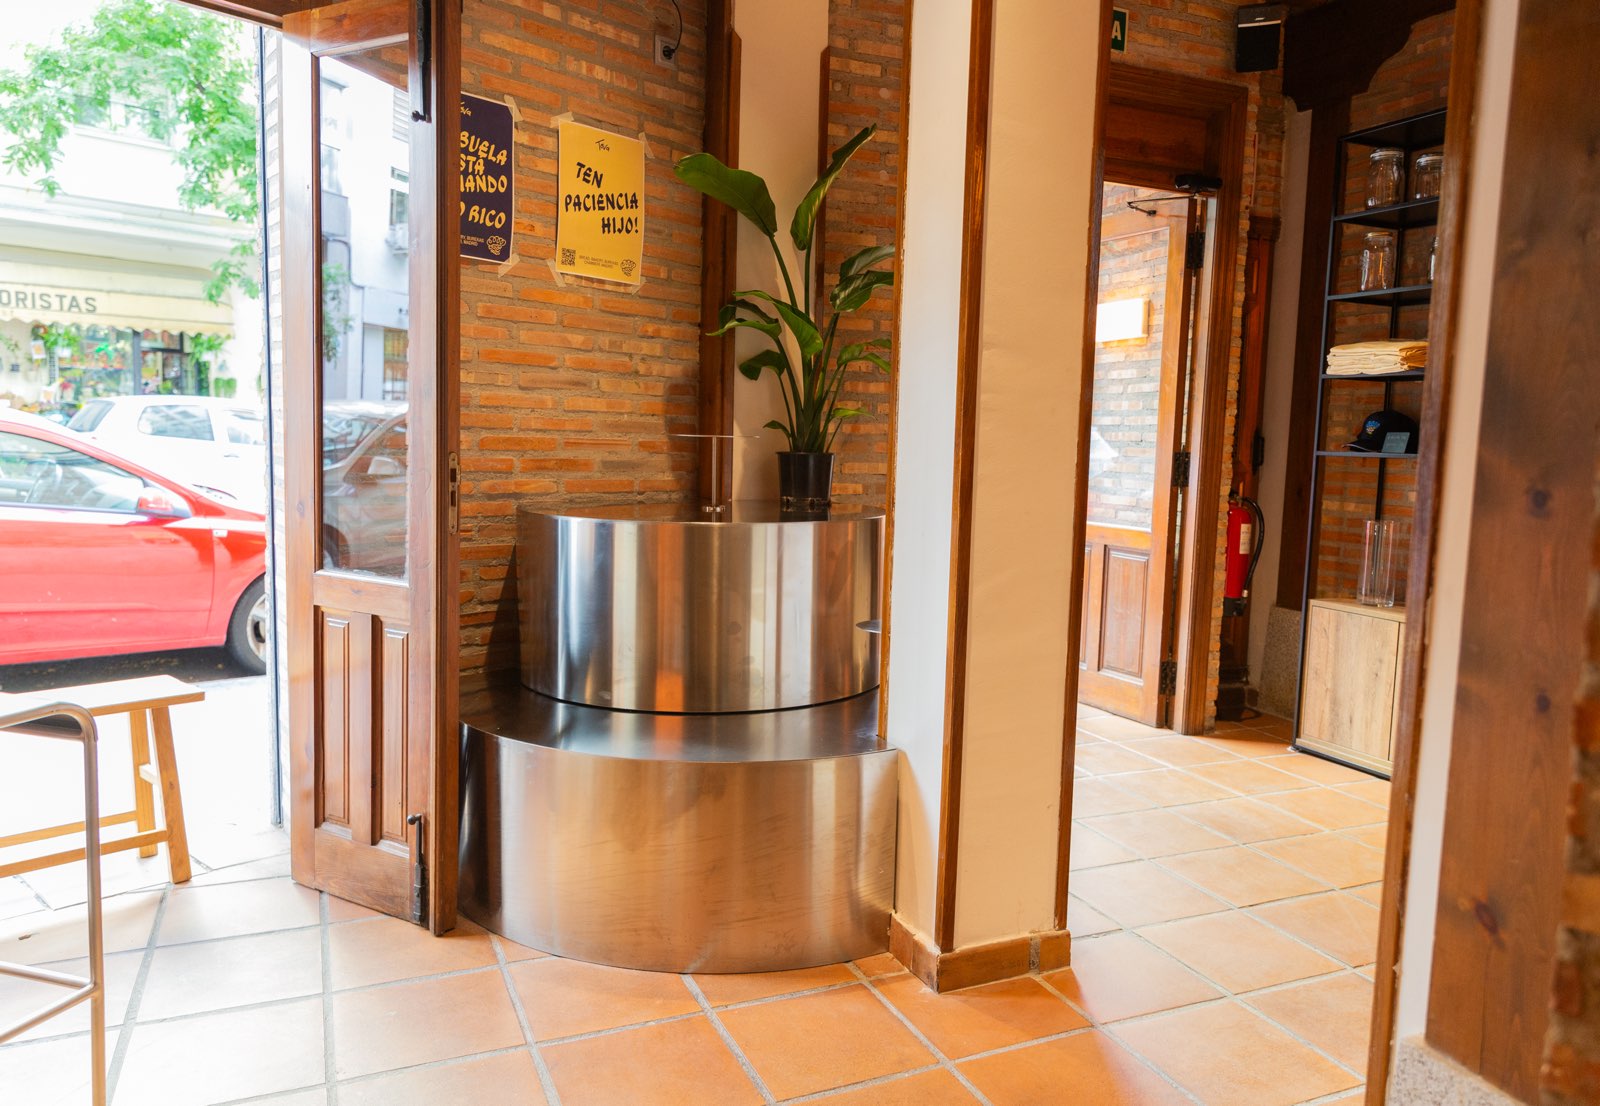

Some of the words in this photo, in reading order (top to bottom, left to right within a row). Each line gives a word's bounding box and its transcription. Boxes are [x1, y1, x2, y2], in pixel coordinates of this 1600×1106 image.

[1111, 20, 1122, 41] A
[576, 161, 604, 189] TEN
[564, 191, 639, 213] PACIENCIA
[468, 204, 507, 229] RICO
[601, 216, 639, 235] HIJO!
[0, 289, 97, 313] ORISTAS
